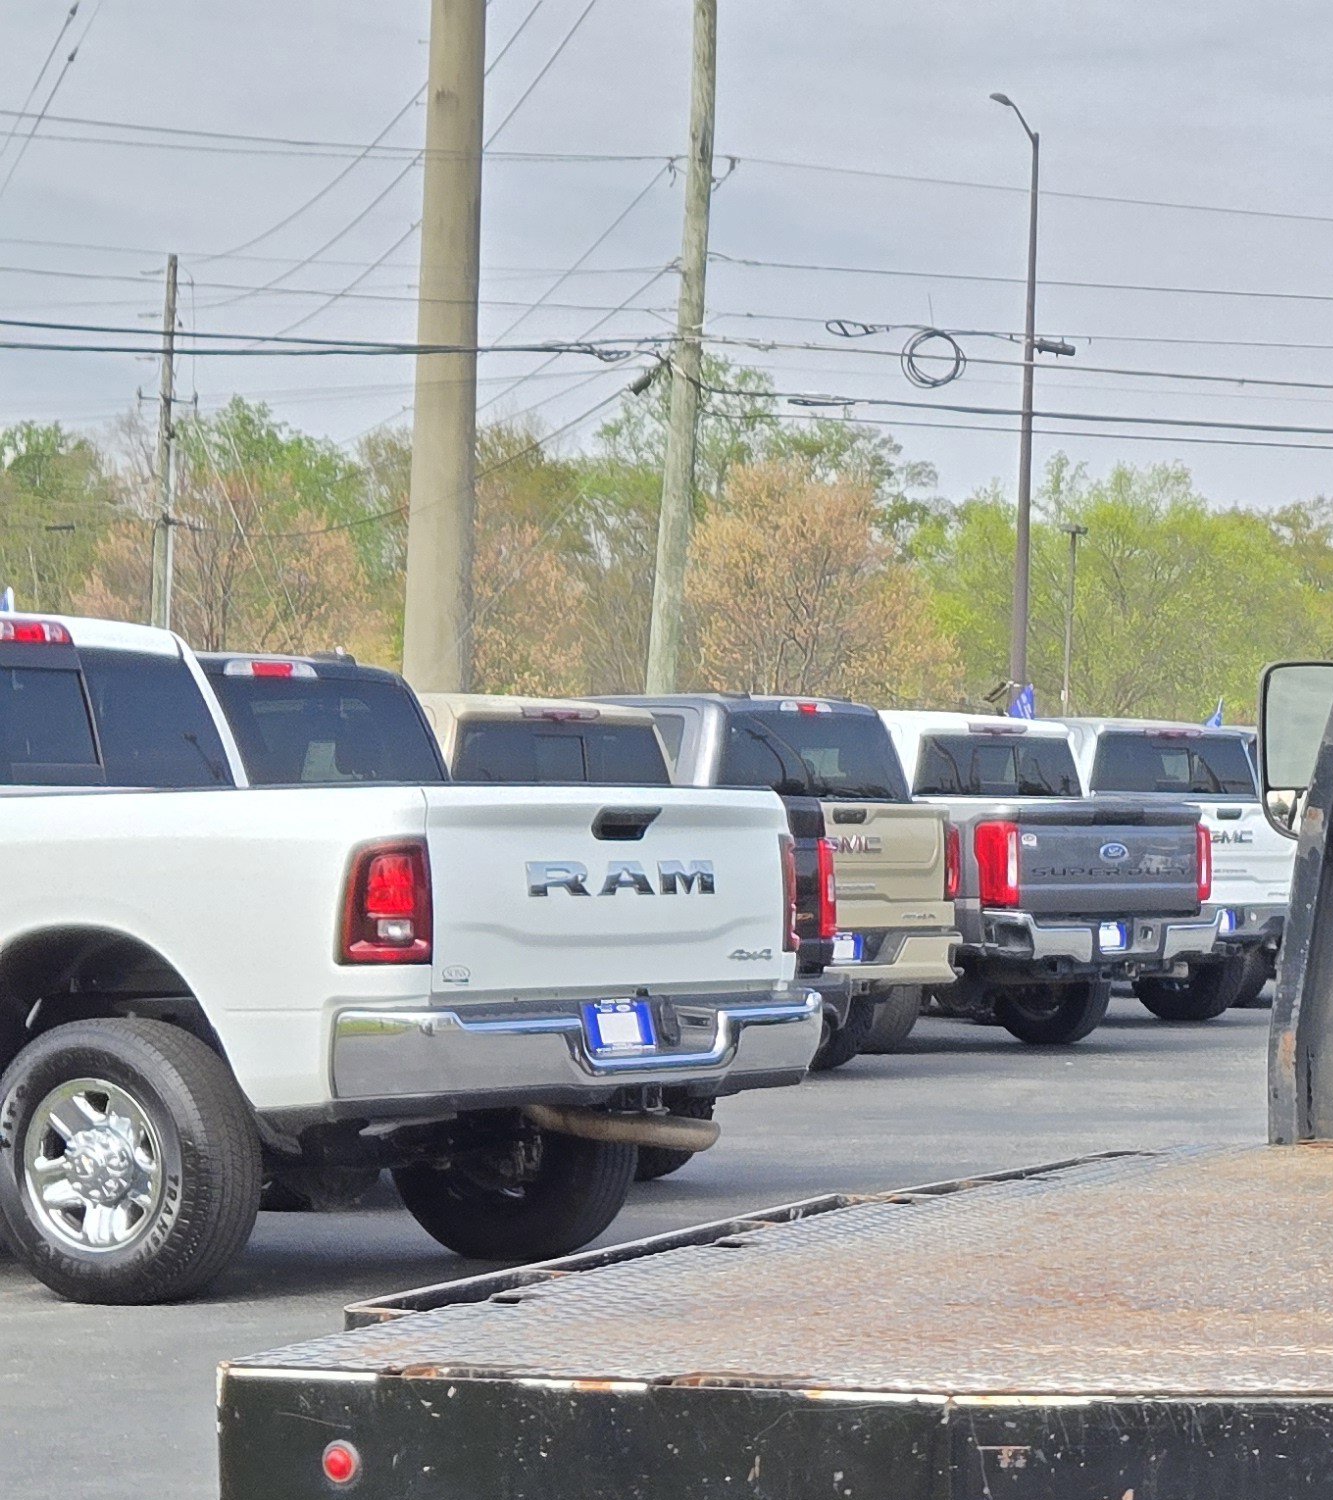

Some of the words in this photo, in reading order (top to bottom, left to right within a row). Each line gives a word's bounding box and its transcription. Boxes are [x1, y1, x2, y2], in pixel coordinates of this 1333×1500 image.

[1211, 830, 1253, 844] GMC
[525, 859, 715, 897] RAM
[1031, 866, 1121, 877] SUPER
[1127, 866, 1192, 876] DUTY
